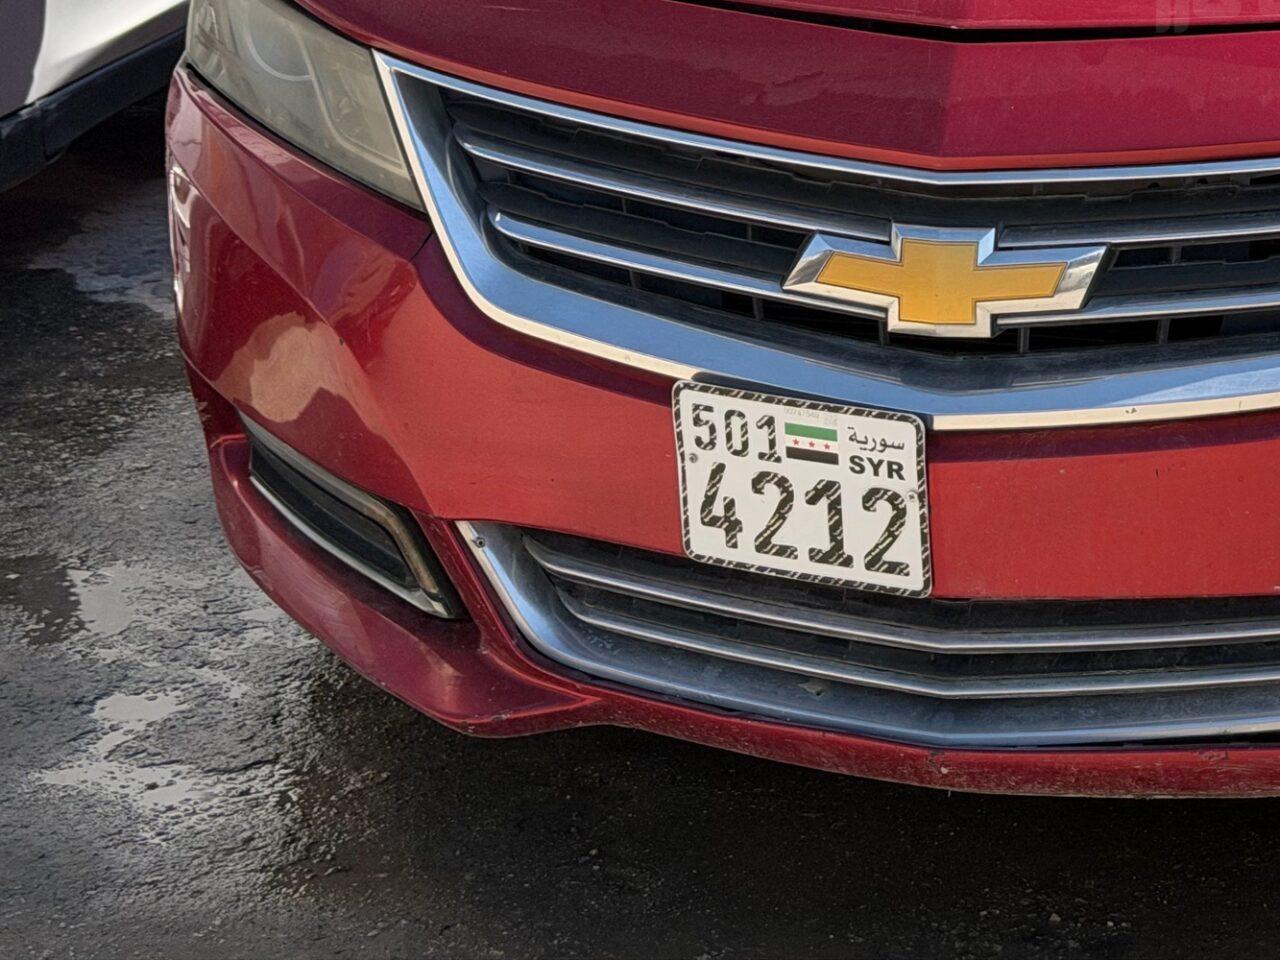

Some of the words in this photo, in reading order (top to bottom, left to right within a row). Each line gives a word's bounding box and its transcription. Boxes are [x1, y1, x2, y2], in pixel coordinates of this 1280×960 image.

[692, 404, 782, 463] 501
[847, 426, 905, 453] سورية
[849, 455, 906, 480] SYR
[700, 462, 910, 576] 4212
